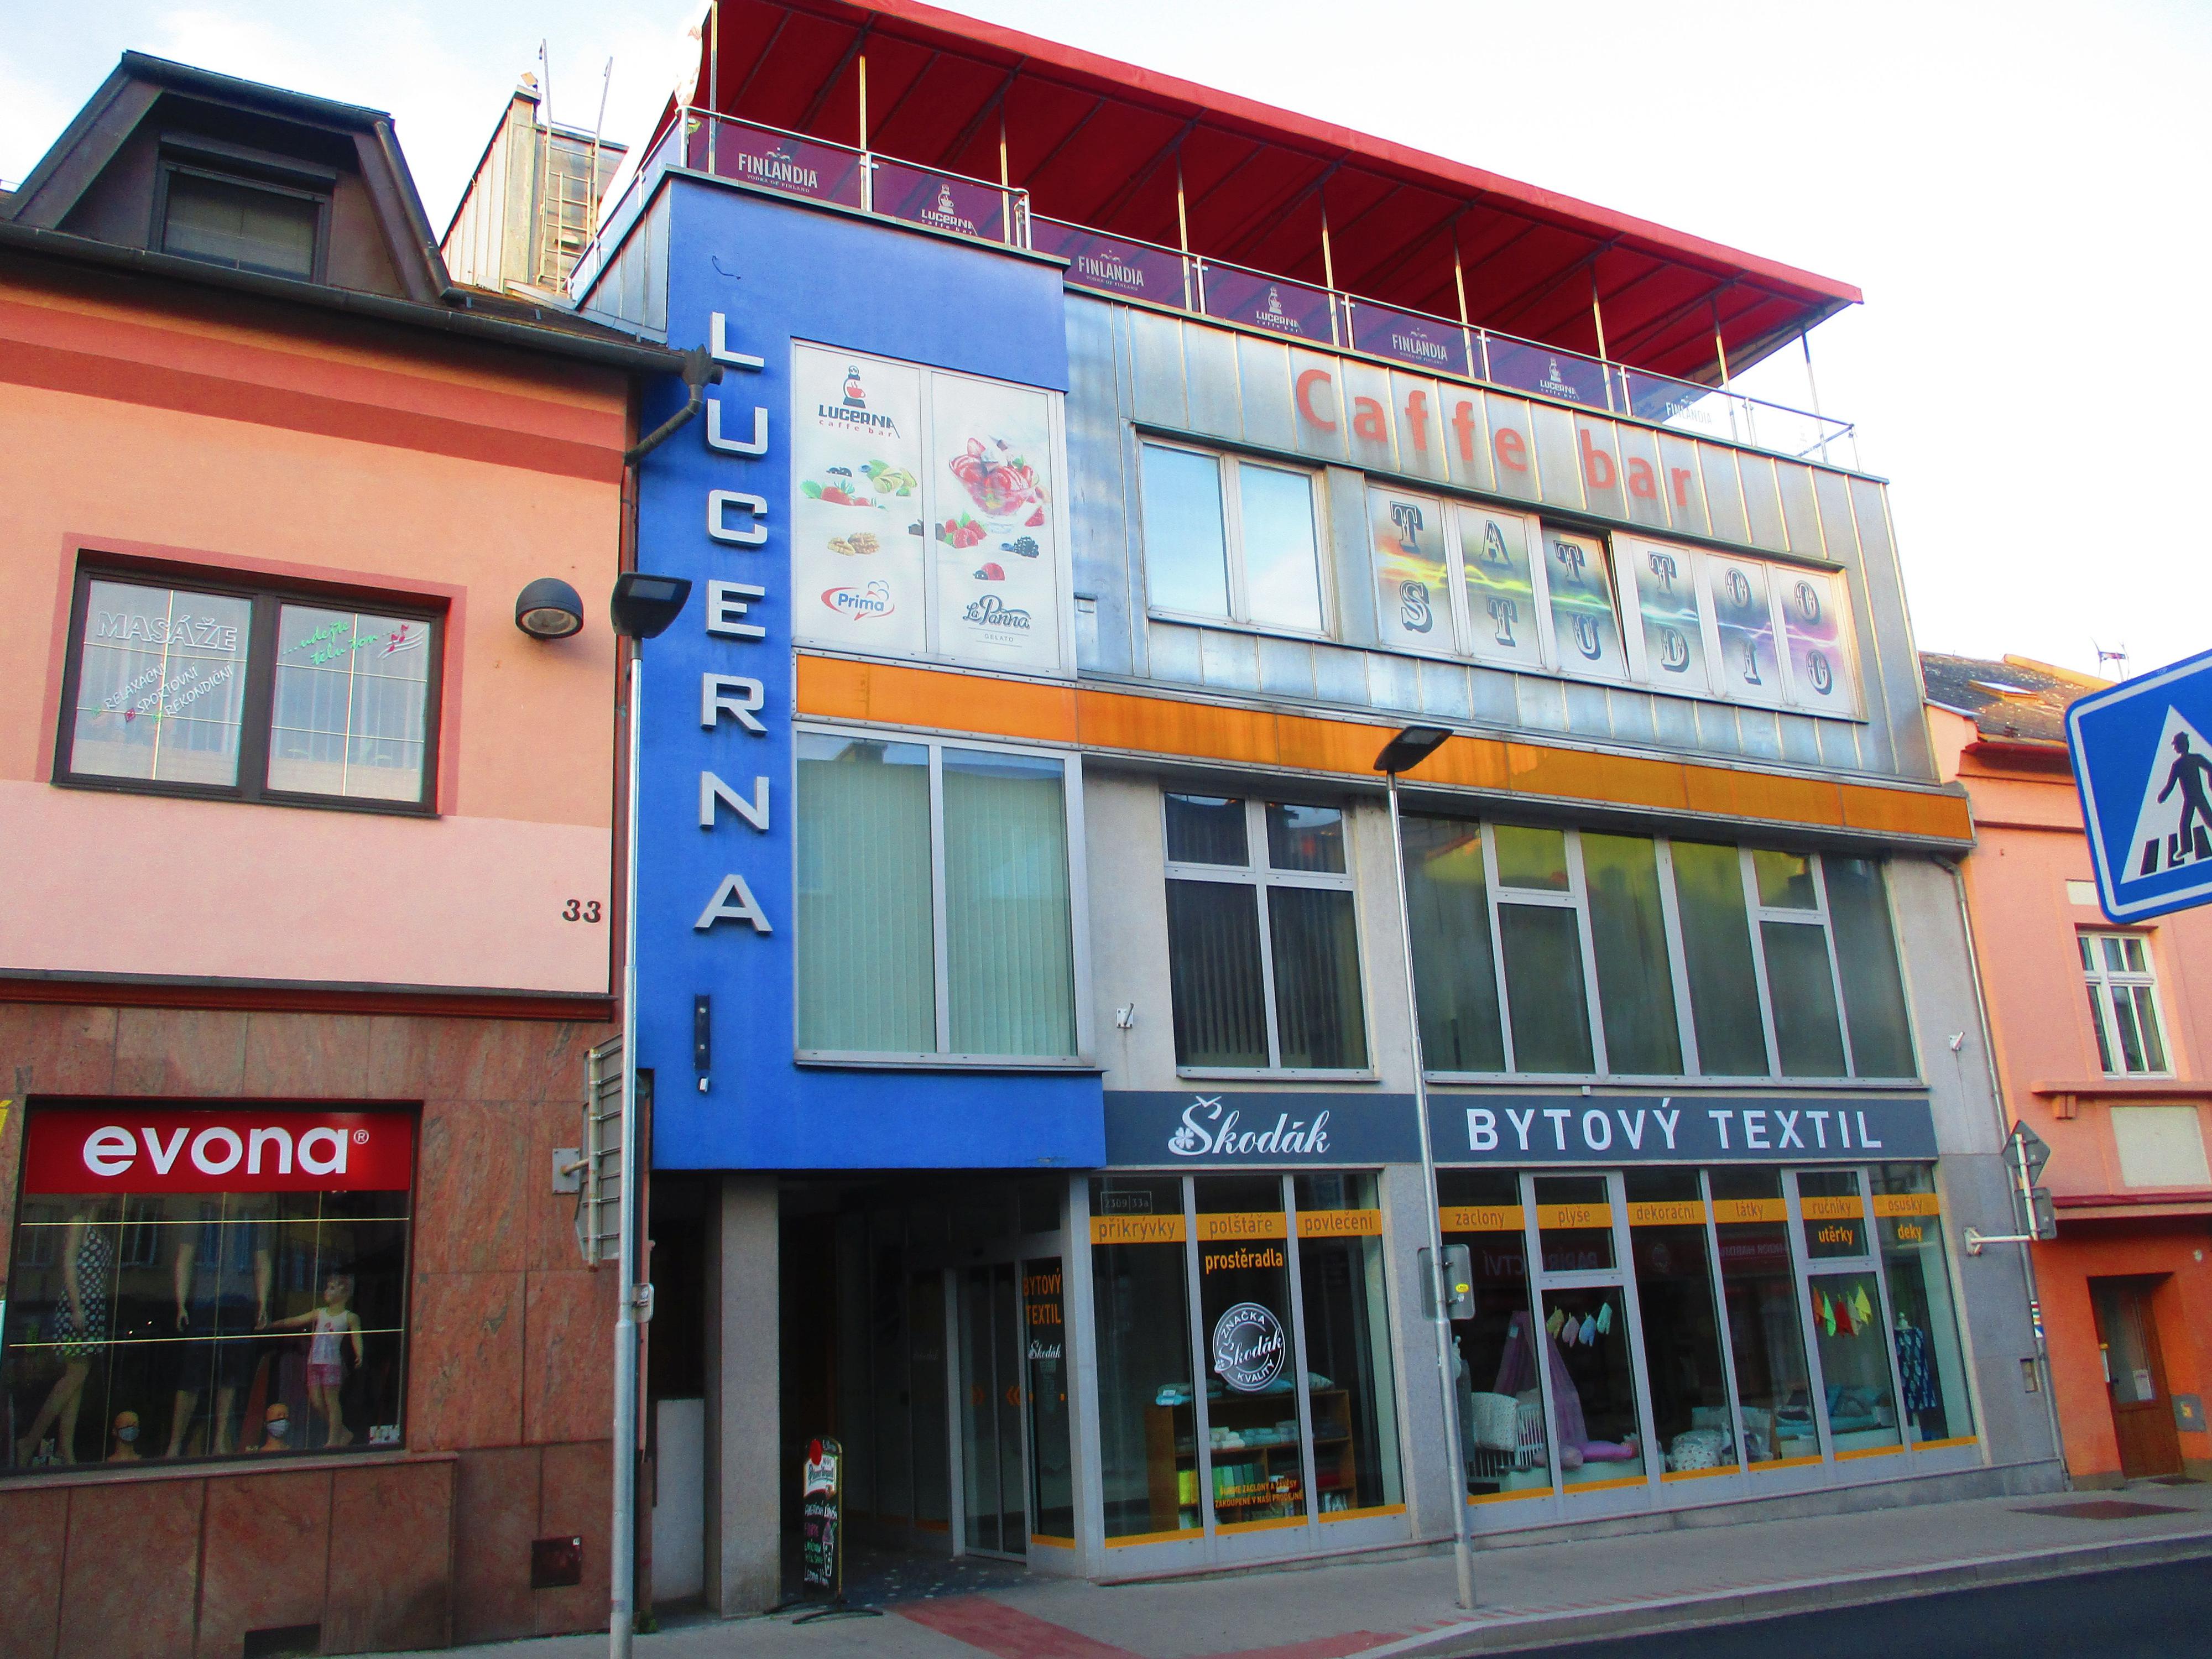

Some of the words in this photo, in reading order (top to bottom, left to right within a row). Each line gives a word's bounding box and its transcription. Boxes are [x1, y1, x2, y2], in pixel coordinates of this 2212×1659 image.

[738, 152, 818, 189] FINLANDIA
[747, 174, 769, 184] VODKA
[781, 182, 810, 193] FINLAND
[921, 208, 978, 236] LUCERNA
[956, 226, 973, 235] bar
[1078, 255, 1145, 286] FINLANDIA
[1256, 310, 1303, 334] LUCERNA
[1392, 333, 1448, 361] FINLANDIA
[1540, 379, 1580, 400] LUCERNA
[818, 404, 900, 439] LUCERNA
[1666, 401, 1713, 425] FINLANDIA
[818, 419, 860, 432] caffe
[868, 426, 893, 438] bar
[1296, 369, 1527, 472] Caffe
[1580, 429, 1692, 507] bar
[1389, 500, 1822, 625] TATTOO
[838, 592, 885, 612] Prima
[962, 601, 980, 622] La
[979, 594, 1031, 629] Panna
[97, 611, 238, 651] MASÁŽE
[694, 311, 773, 933] LUCERNA
[984, 634, 1014, 642] GELATO
[1399, 580, 1833, 696] STUDIO
[104, 658, 166, 709] RELAXAČNÍ
[137, 662, 199, 713] SPORTOVNÍ
[164, 661, 234, 717] REKONDIČNÍ
[562, 899, 602, 924] 33
[1167, 1095, 1330, 1156] Škodák
[1467, 1098, 1681, 1152] BYTOVÝ
[1709, 1110, 1882, 1150] TEXTIL
[1558, 1206, 1591, 1226] plyše
[1636, 1202, 1695, 1221] dekorační
[1735, 1200, 1764, 1220] látky
[1812, 1196, 1851, 1217] ručníky
[1887, 1194, 1923, 1214] osušky
[1099, 1216, 1176, 1241] přikrývky
[1209, 1214, 1272, 1238] polštáře
[1305, 1211, 1373, 1234] povlečení
[1455, 1209, 1506, 1228] záclony
[1818, 1224, 1854, 1245] utěrky
[1897, 1223, 1923, 1244] deky
[1205, 1248, 1284, 1275] prostěradla
[1023, 1268, 1062, 1296] BYTOVÝ
[1025, 1303, 1062, 1325] TEXTIL
[1221, 1311, 1266, 1338] ZNAČKA
[1028, 1339, 1062, 1359] Škodák
[1214, 1327, 1284, 1373] Škodák
[1237, 1359, 1275, 1383] KVALITY
[1215, 1495, 1251, 1509] ZAKOUPENÉ
[1273, 1489, 1304, 1503] PRODEJNĚ
